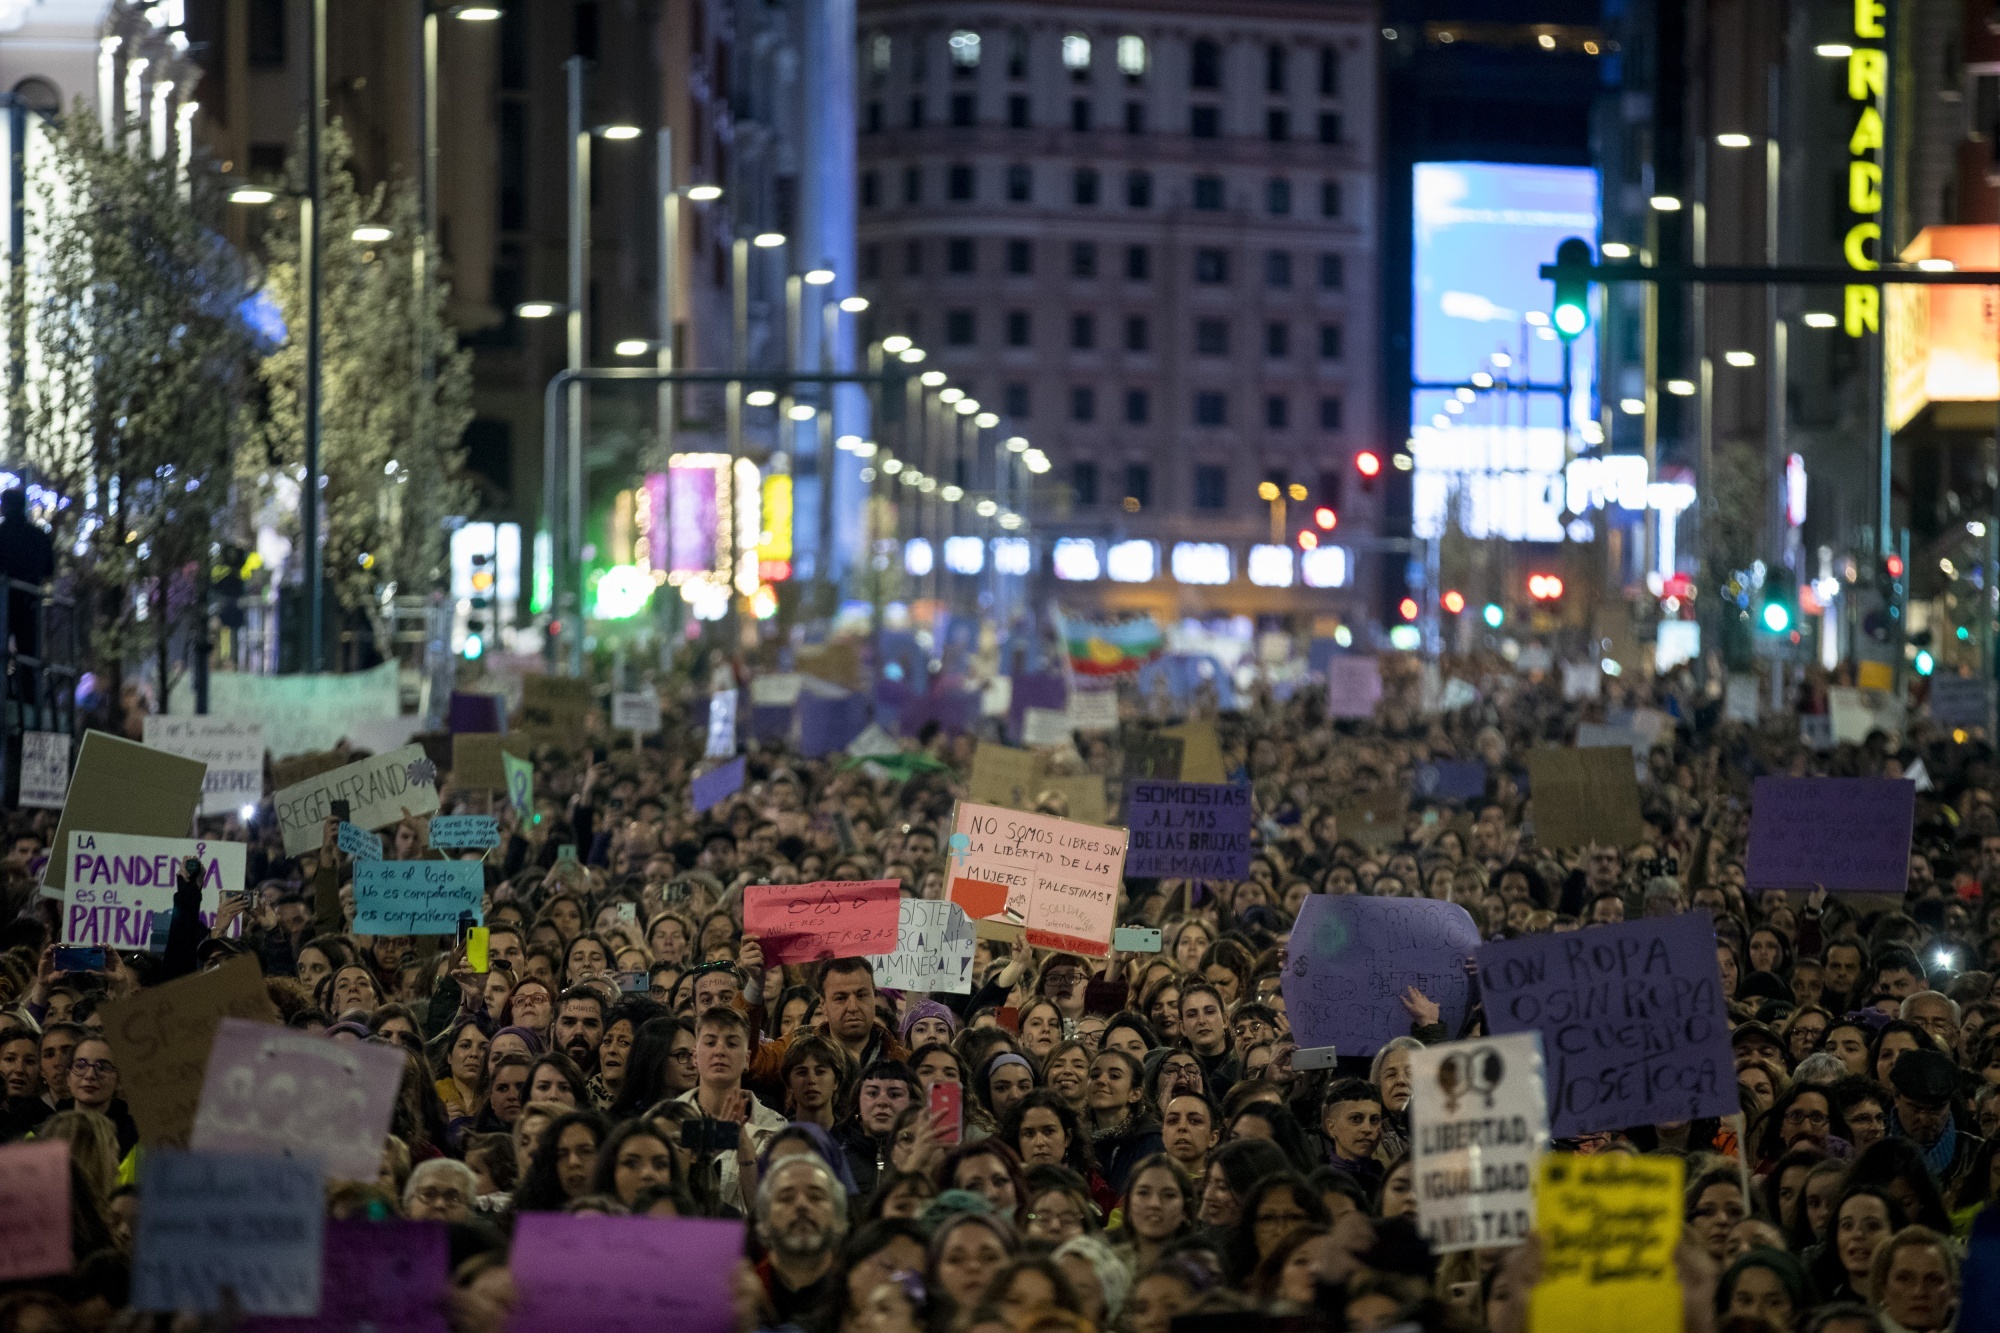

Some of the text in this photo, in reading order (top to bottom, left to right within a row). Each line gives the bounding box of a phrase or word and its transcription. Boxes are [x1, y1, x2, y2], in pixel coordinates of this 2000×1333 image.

[1136, 785, 1210, 805] SOMOS
[1145, 808, 1217, 829] ALMAS
[77, 834, 96, 850] LA
[969, 815, 1122, 856] NO SOMOS LIBRES SIN
[1135, 831, 1246, 853] DE LAS BRUJAS
[970, 840, 1110, 875] LA LIBERTAD DE LAS
[380, 866, 396, 882] de
[425, 866, 455, 884] lado
[966, 865, 1112, 906] MUJERES PALESTINAS!
[75, 888, 96, 903] es
[362, 884, 378, 898] No
[383, 888, 400, 899] es
[361, 910, 378, 921] es
[766, 918, 825, 939] MUJERES
[1482, 936, 1672, 992] CON ROPA
[1623, 976, 1715, 1019] ROPA
[1556, 1016, 1712, 1054] CUERPO
